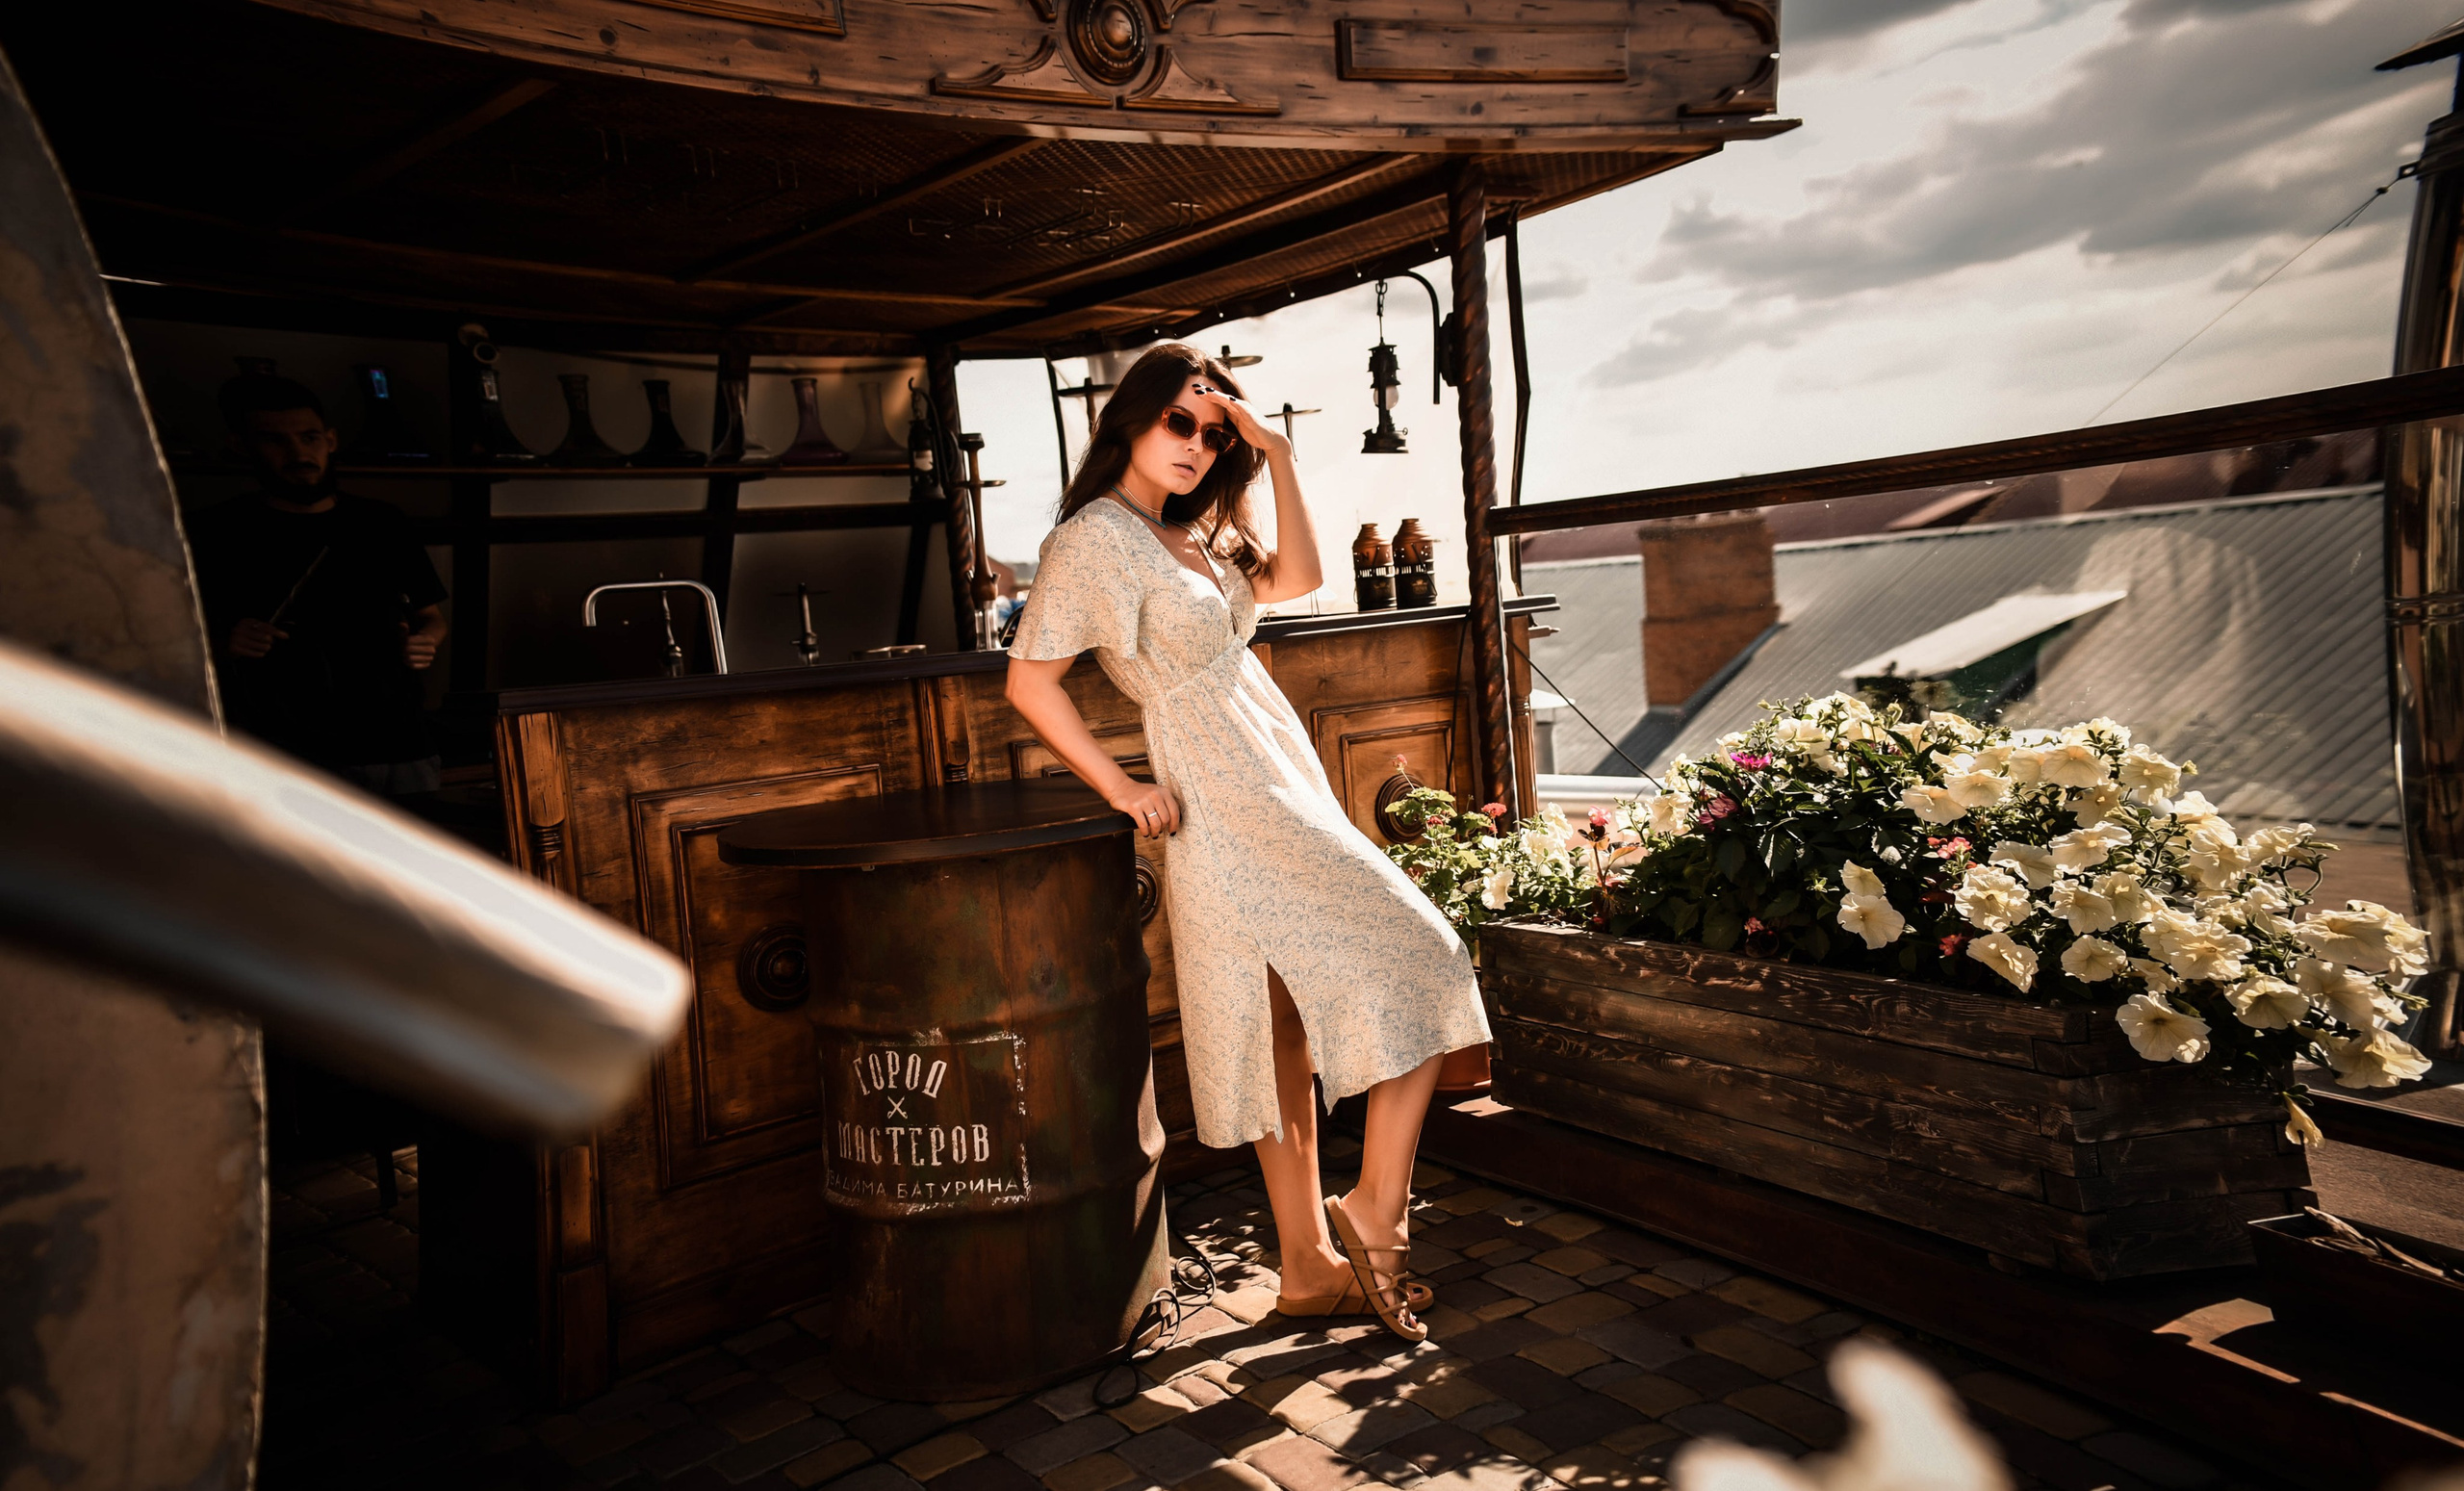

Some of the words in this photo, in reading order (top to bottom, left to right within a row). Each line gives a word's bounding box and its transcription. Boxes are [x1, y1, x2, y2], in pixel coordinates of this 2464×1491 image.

[853, 1050, 947, 1098] ГОРОД
[837, 1120, 989, 1167] МАСТЕРОВ
[829, 1170, 886, 1196] ВАДИМА
[897, 1177, 1019, 1199] БАТУРИНА
